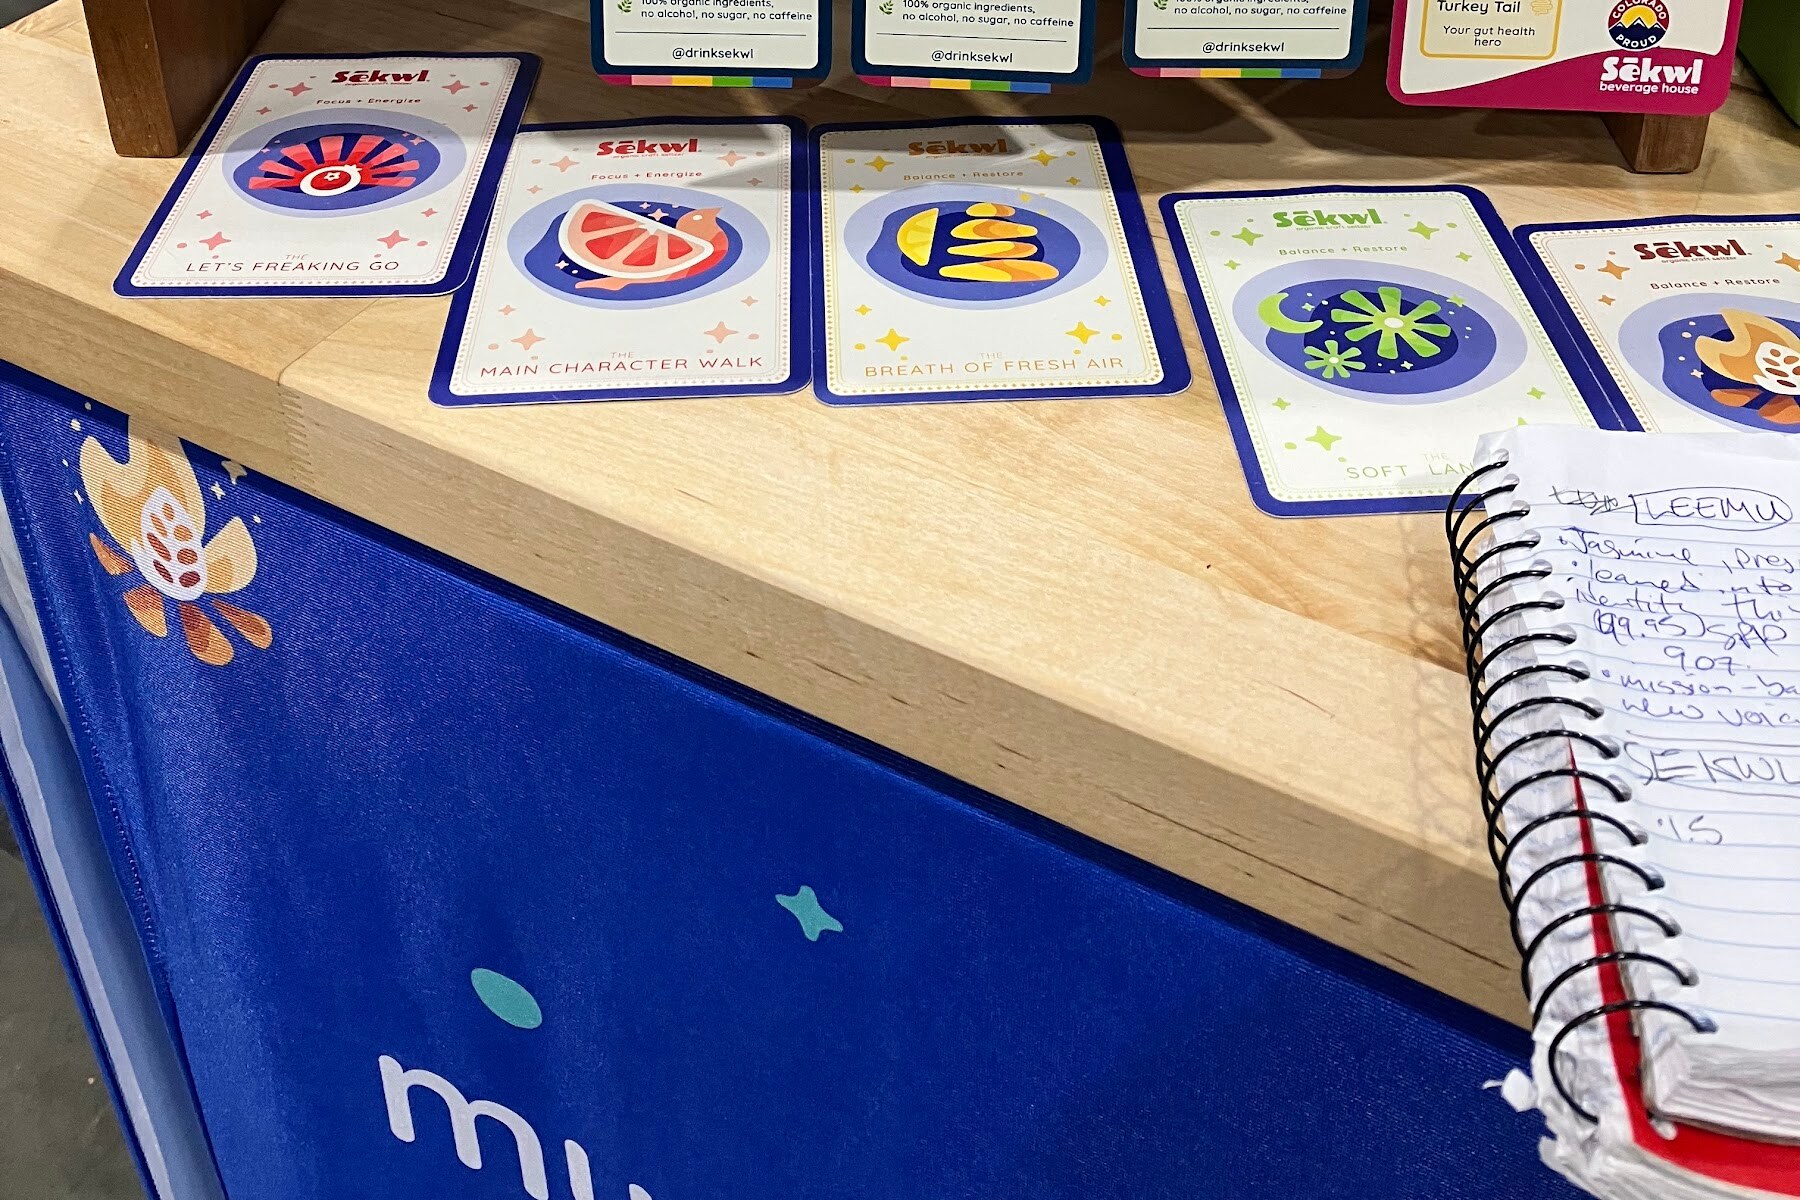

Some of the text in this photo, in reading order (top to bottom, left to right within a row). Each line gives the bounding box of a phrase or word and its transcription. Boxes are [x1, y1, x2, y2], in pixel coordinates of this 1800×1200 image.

[1437, 0, 1521, 15] Turkey Tail
[641, 9, 812, 21] no alcohol, no sugar, no caffeine
[1443, 25, 1536, 38] Your gut health
[1202, 41, 1285, 53] @drinksekwl
[1474, 36, 1502, 47] hero
[1615, 33, 1658, 49] PROUD
[672, 47, 754, 60] @drinksekwl
[1279, 244, 1408, 256] Balance Restore
[186, 260, 400, 273] LET'S FREAKING GO
[1650, 278, 1781, 290] Balance Restore
[481, 357, 763, 378] MAIN CHARACTER WALK
[865, 358, 1124, 377] BREATH OF FRESH AIR
[1346, 463, 1473, 480] SOFT LAN
